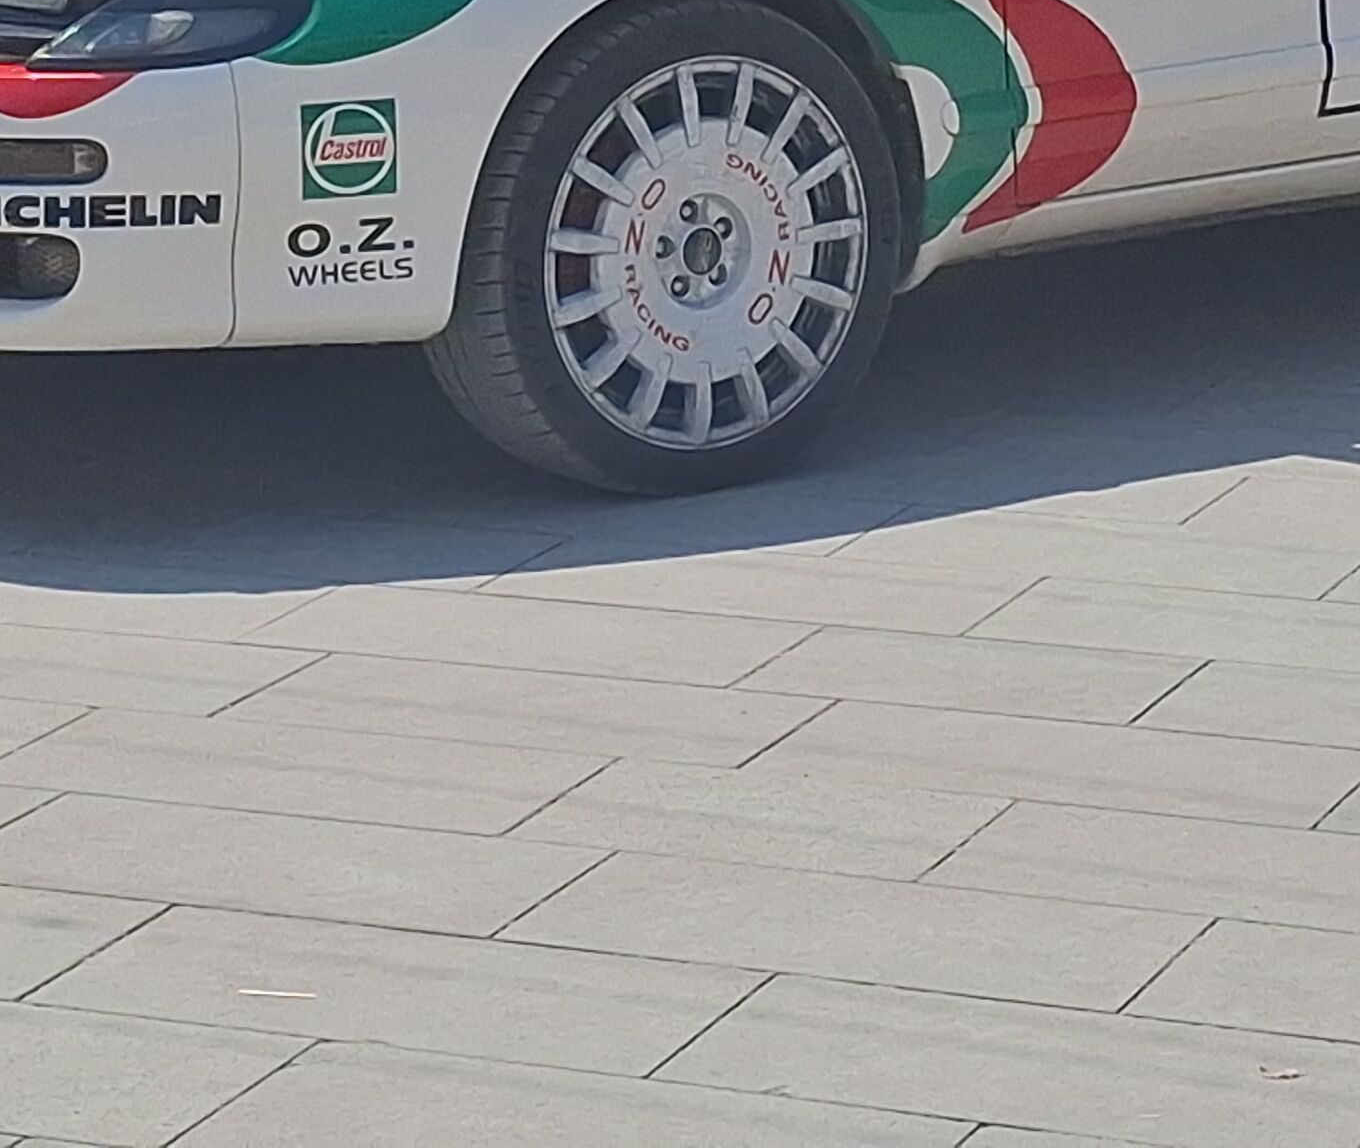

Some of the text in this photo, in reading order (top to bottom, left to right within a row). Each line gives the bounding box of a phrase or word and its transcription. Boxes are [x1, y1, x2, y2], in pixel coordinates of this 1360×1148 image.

[319, 136, 388, 162] Castrol
[723, 152, 794, 242] RACING
[286, 216, 415, 259] O.Z.
[287, 257, 415, 288] WHEELS
[623, 264, 692, 353] RACING
